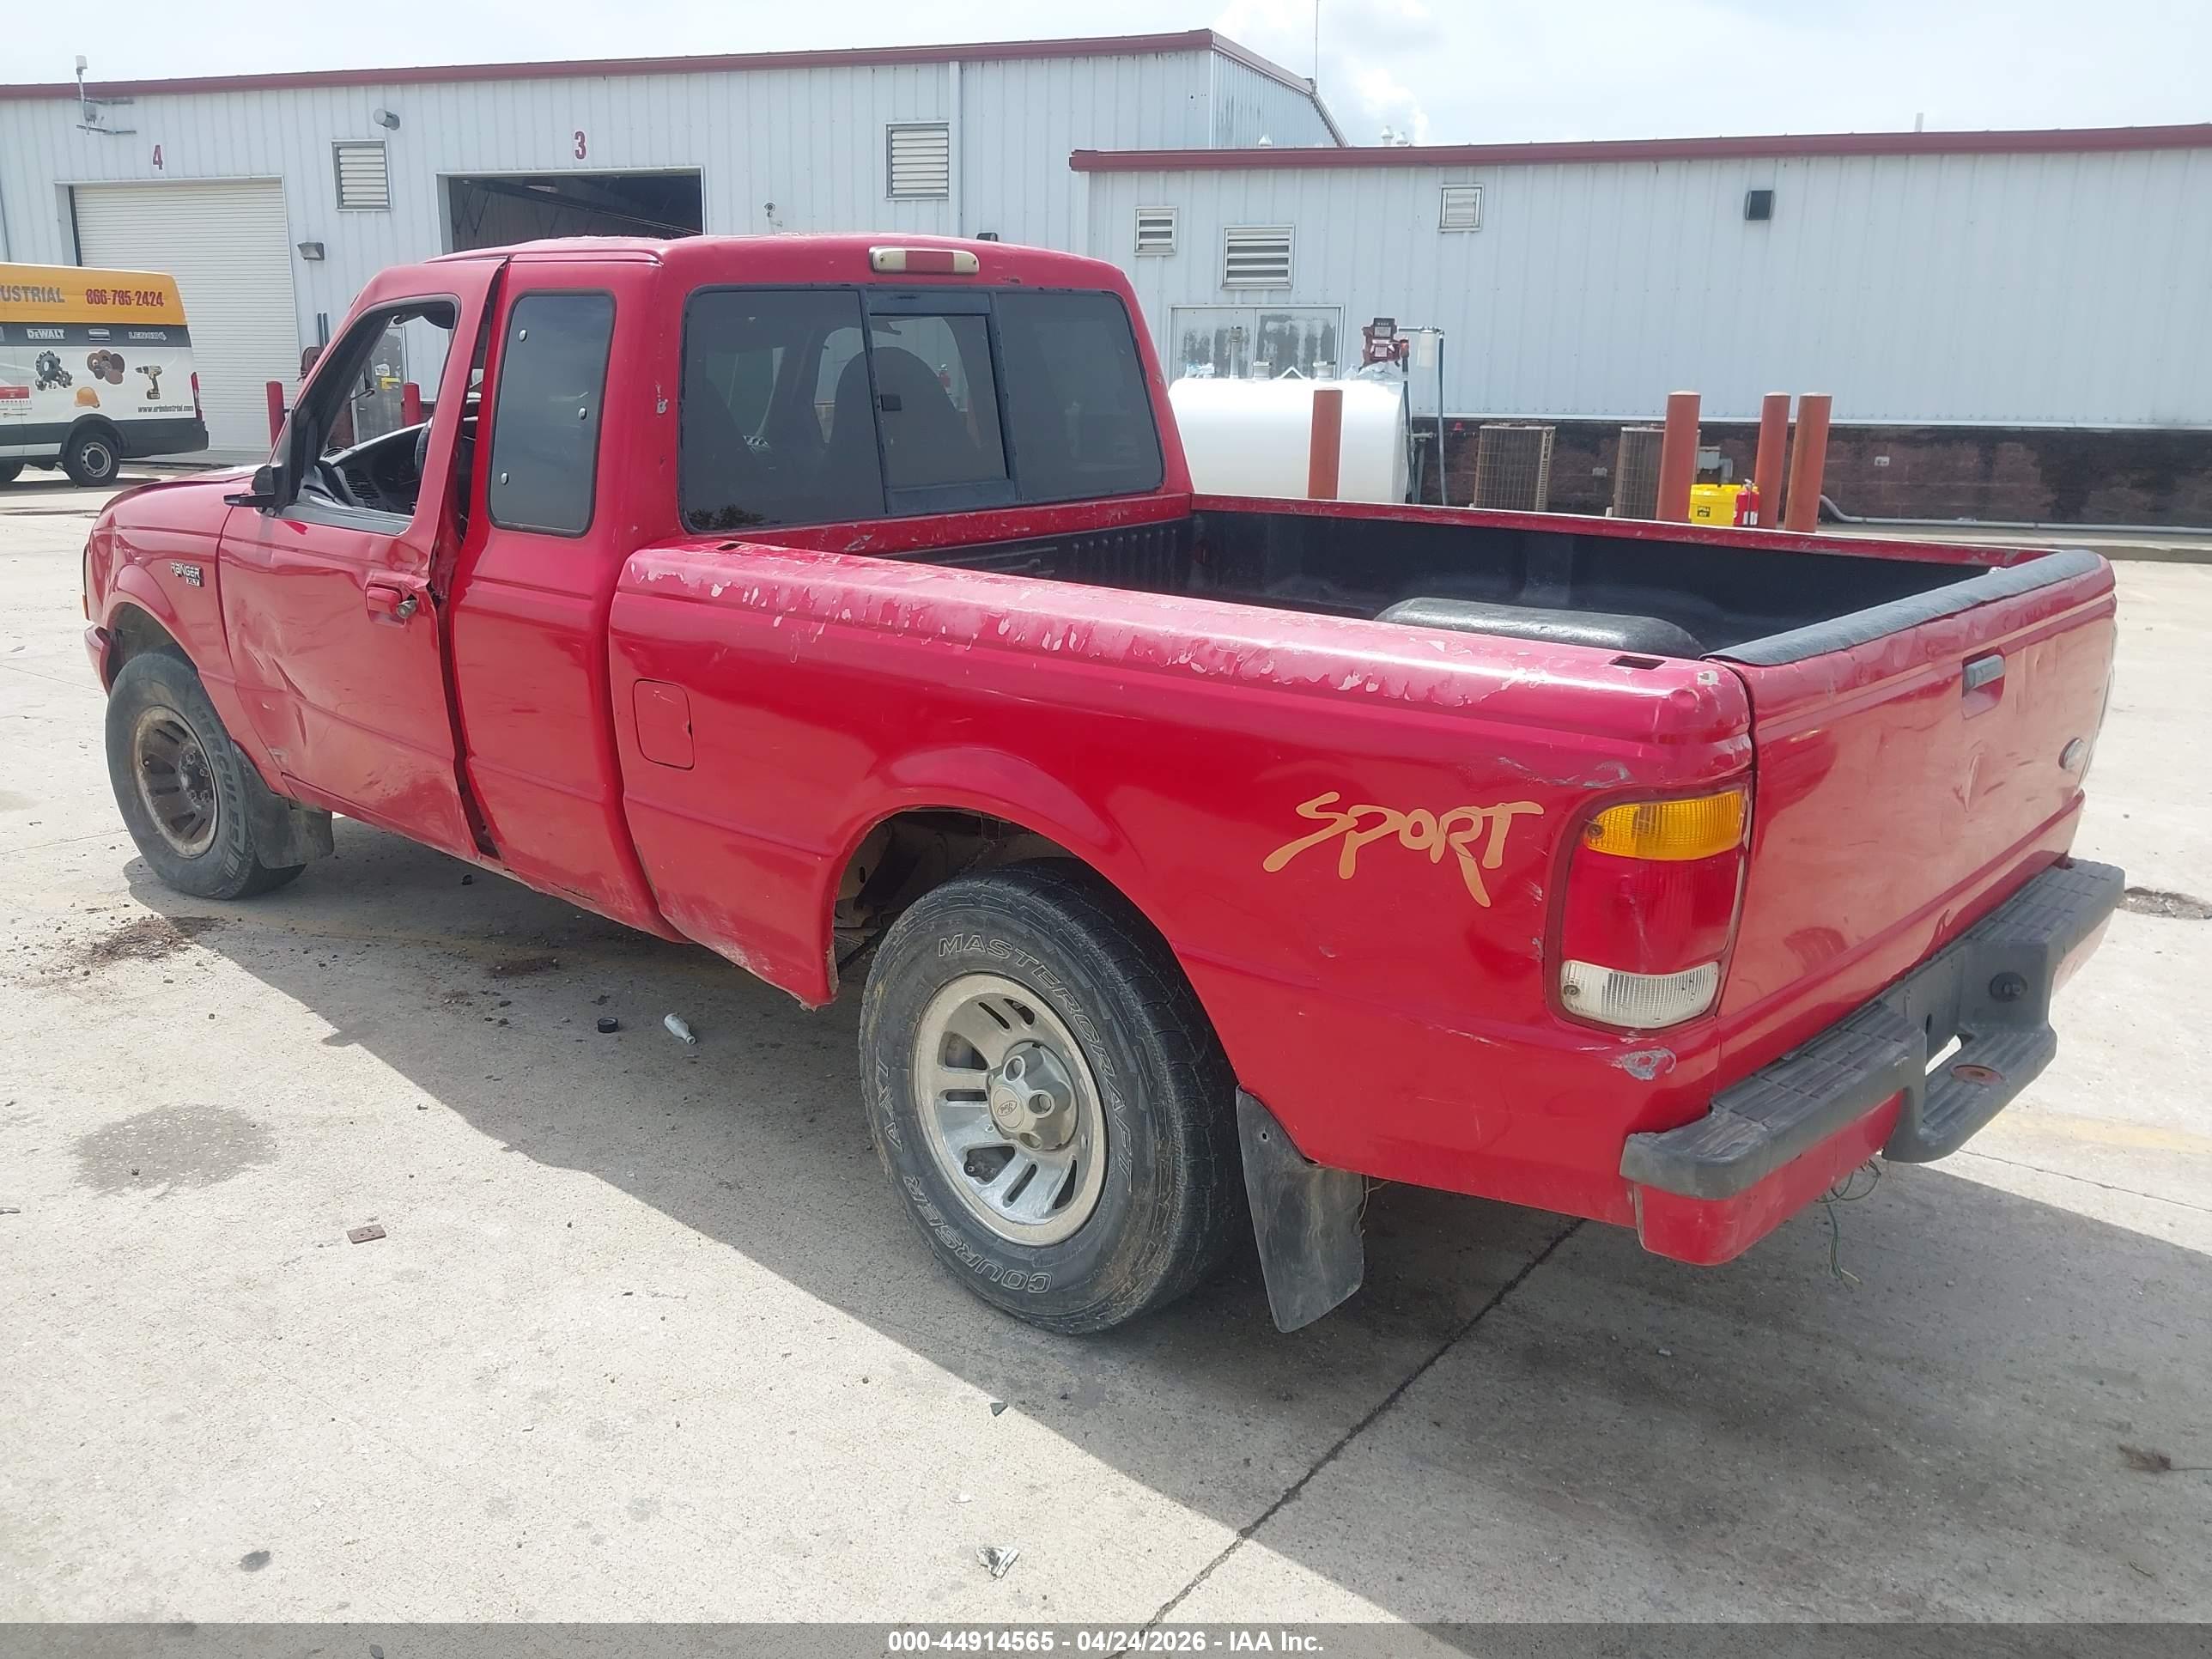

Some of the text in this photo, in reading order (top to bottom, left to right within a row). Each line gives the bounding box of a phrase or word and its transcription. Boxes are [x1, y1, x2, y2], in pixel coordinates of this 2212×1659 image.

[152, 144, 163, 170] 4
[574, 131, 586, 160] 3
[0, 285, 65, 303] USTRIAL
[193, 705, 240, 842] HERCULES
[1262, 791, 1545, 908] SPORT
[939, 933, 1133, 1195] MASTERCRAFT
[902, 1175, 1053, 1294] COURSER
